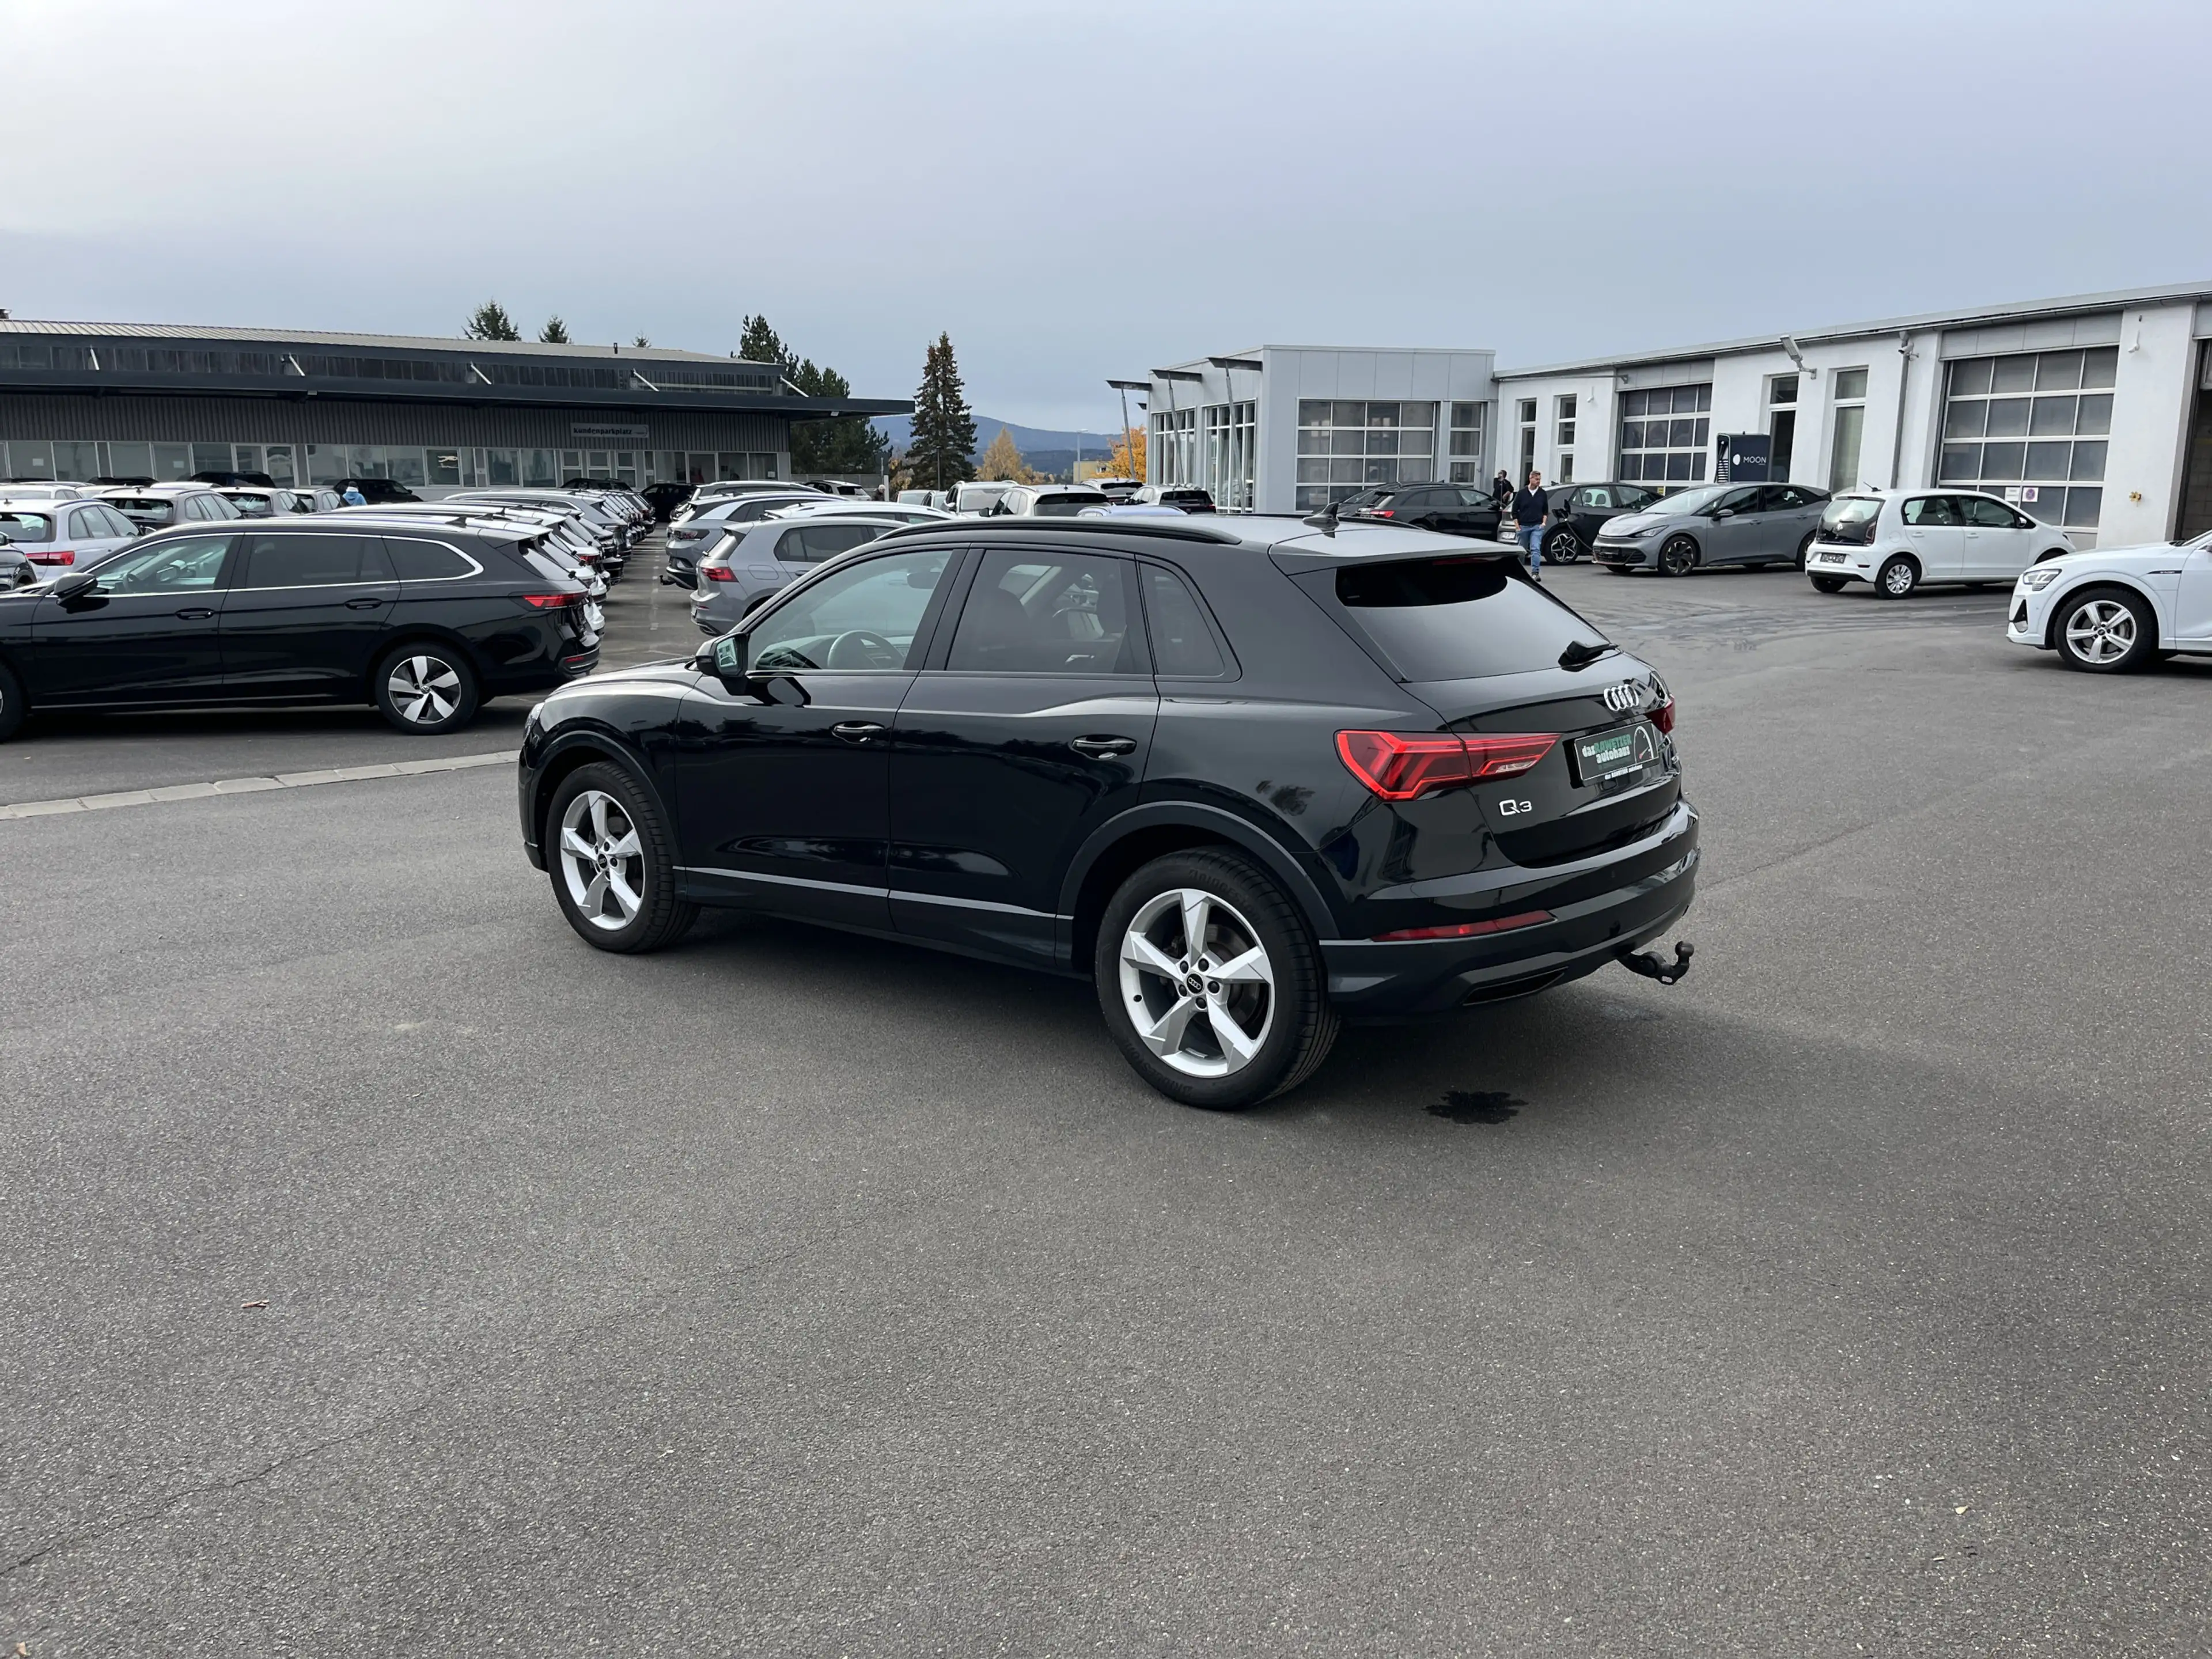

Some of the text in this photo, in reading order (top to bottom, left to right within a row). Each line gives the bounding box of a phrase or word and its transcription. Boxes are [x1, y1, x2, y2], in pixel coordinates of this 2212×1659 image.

[573, 427, 632, 435] Kundenparkplatz
[1743, 456, 1767, 464] MOON
[1596, 745, 1631, 764] autohaus
[1499, 800, 1532, 816] Q3
